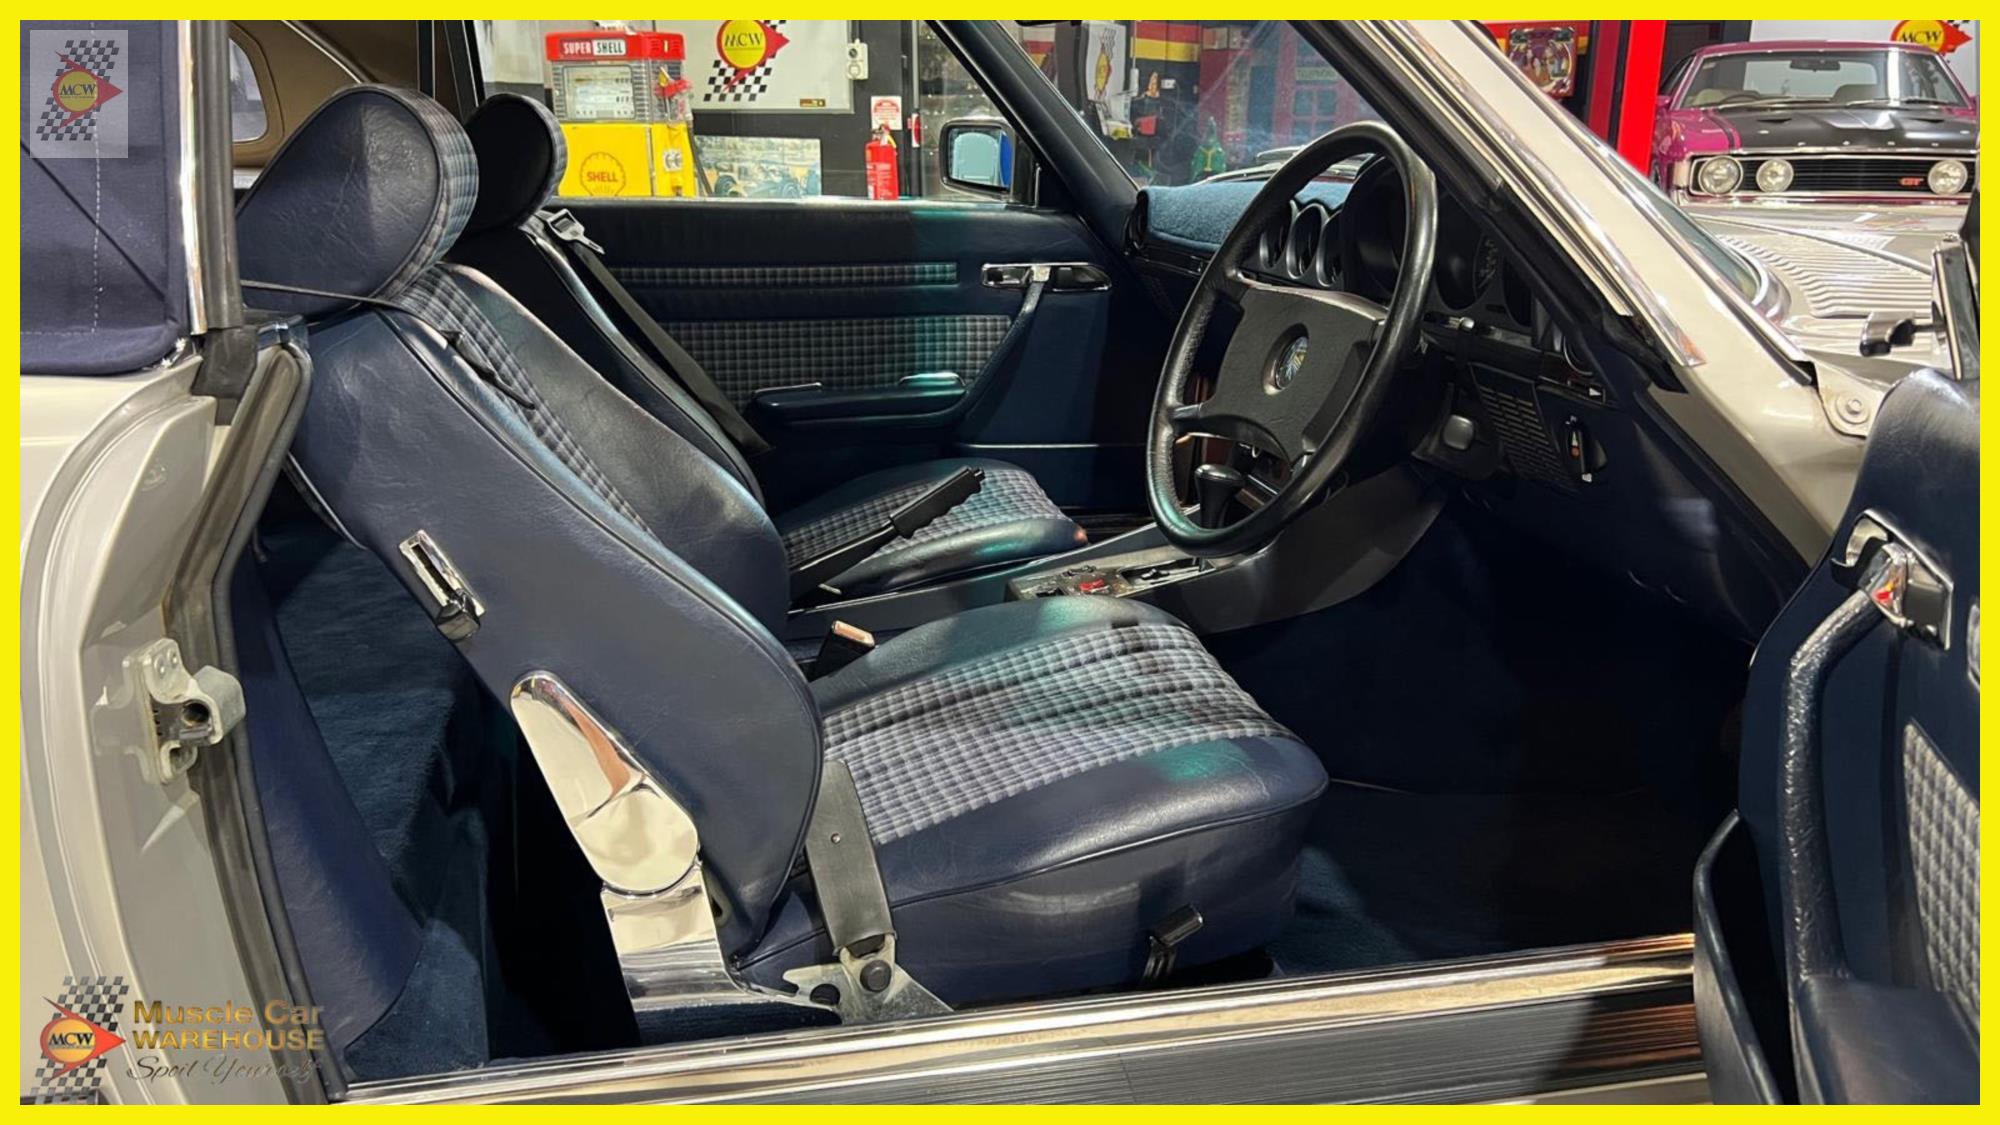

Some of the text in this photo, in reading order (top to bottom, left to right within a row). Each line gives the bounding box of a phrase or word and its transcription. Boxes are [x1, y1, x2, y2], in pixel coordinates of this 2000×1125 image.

[724, 33, 763, 47] MCW
[1900, 31, 1941, 44] MCW
[563, 42, 623, 54] SUPER SHELL
[587, 171, 618, 182] SHELL
[1900, 178, 1924, 186] GT
